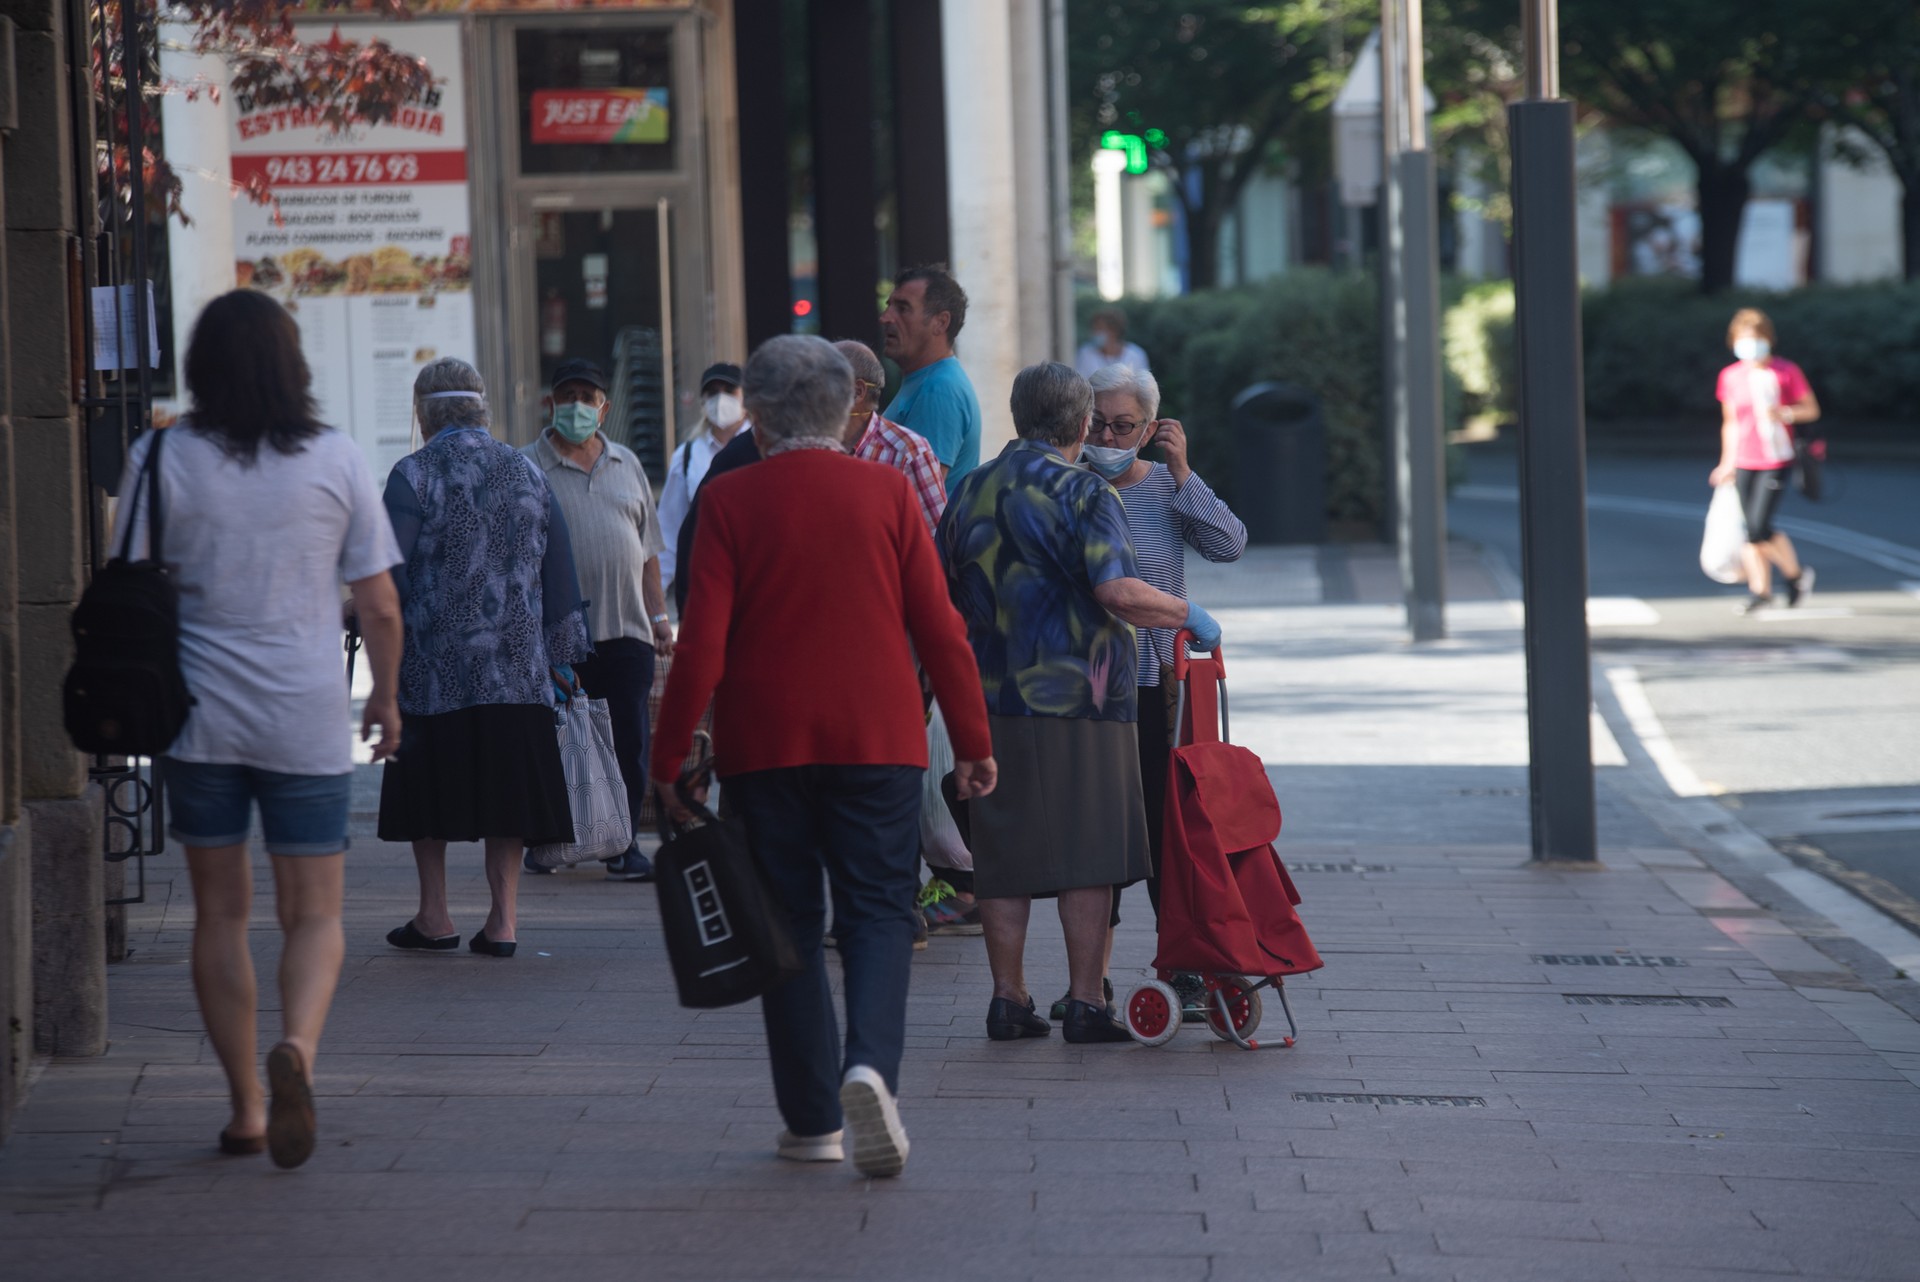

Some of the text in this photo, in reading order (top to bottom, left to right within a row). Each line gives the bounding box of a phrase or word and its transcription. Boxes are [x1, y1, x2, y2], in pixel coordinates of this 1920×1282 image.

[237, 102, 372, 142] ESTRE
[542, 98, 652, 128] JUST EAT
[265, 153, 419, 184] 943 24 76 93
